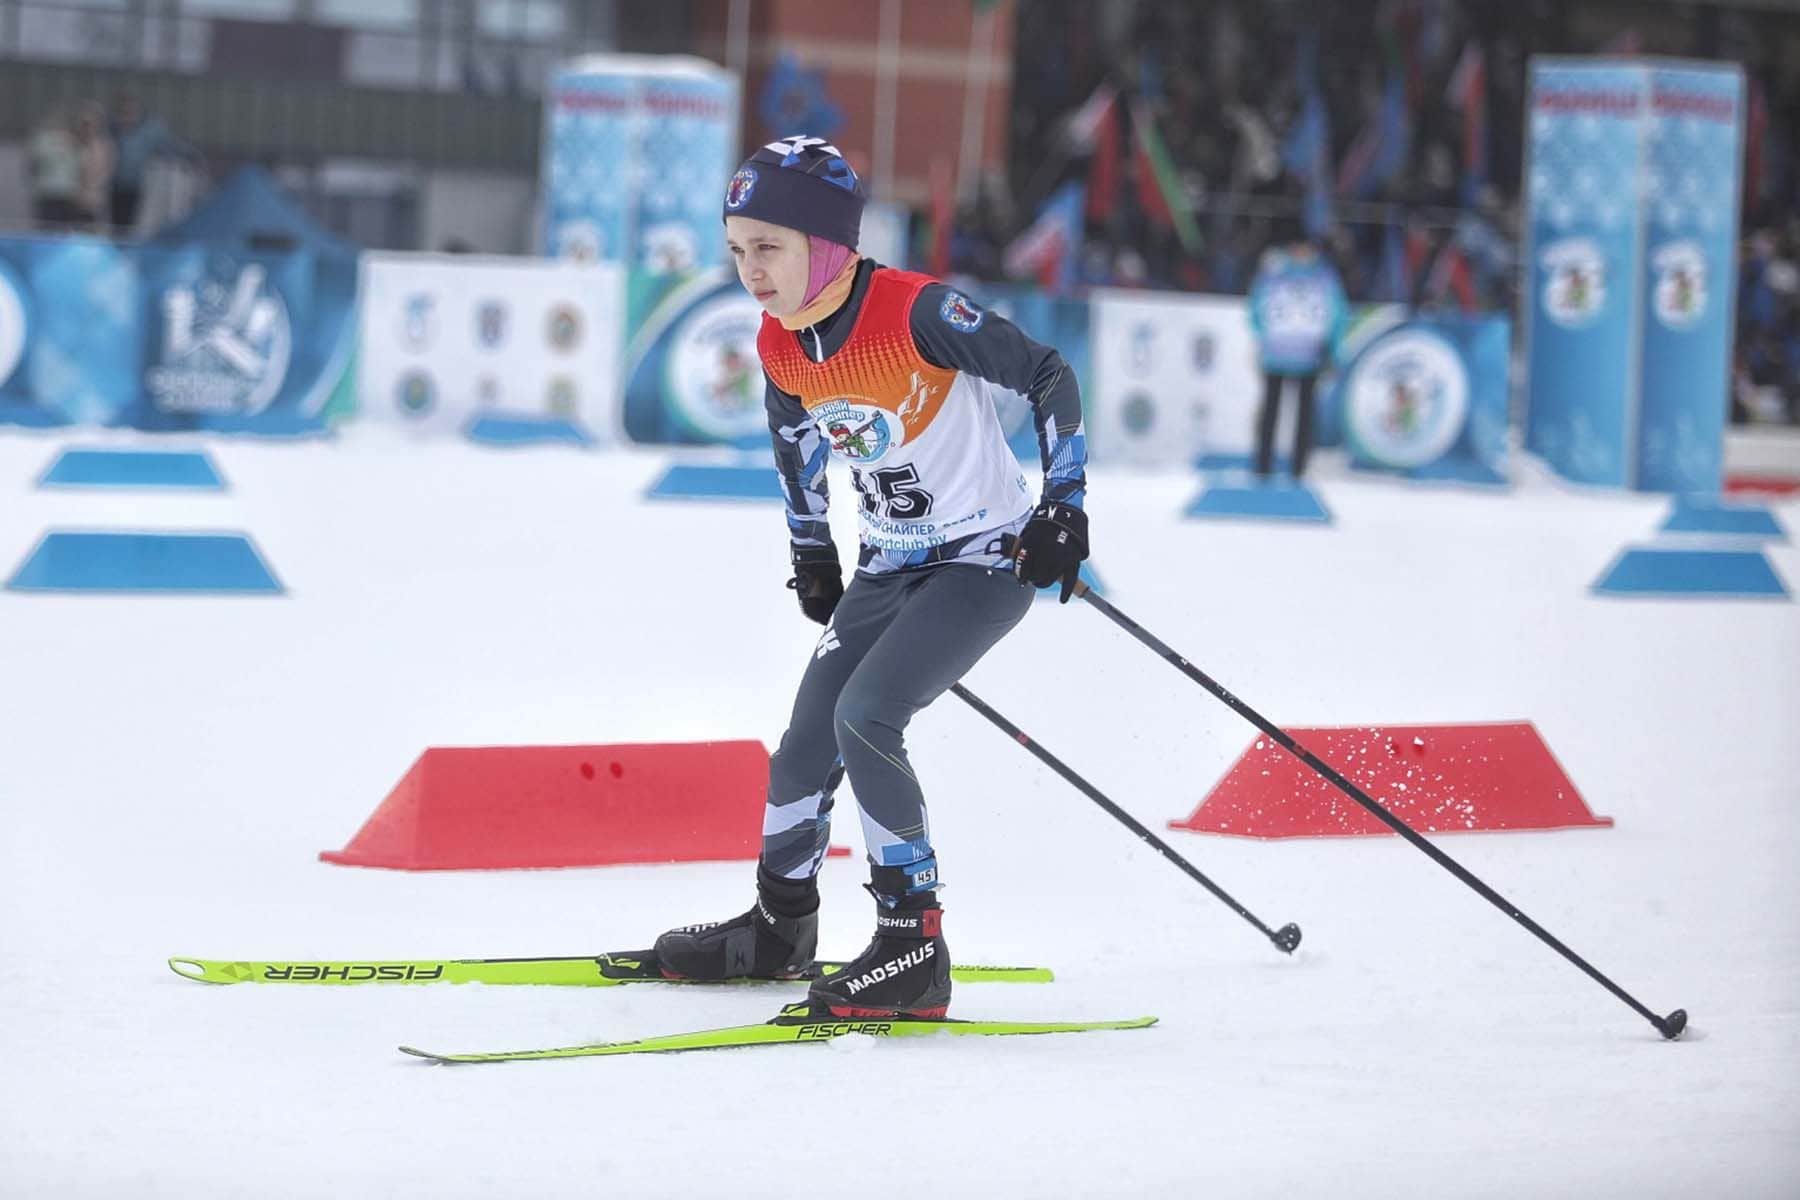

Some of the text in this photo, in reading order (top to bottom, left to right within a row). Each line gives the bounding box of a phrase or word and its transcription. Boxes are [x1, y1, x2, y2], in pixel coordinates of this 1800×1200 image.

[264, 964, 444, 981] FISCHER
[847, 941, 936, 996] MADSHUS
[797, 1023, 892, 1039] FISCHER
